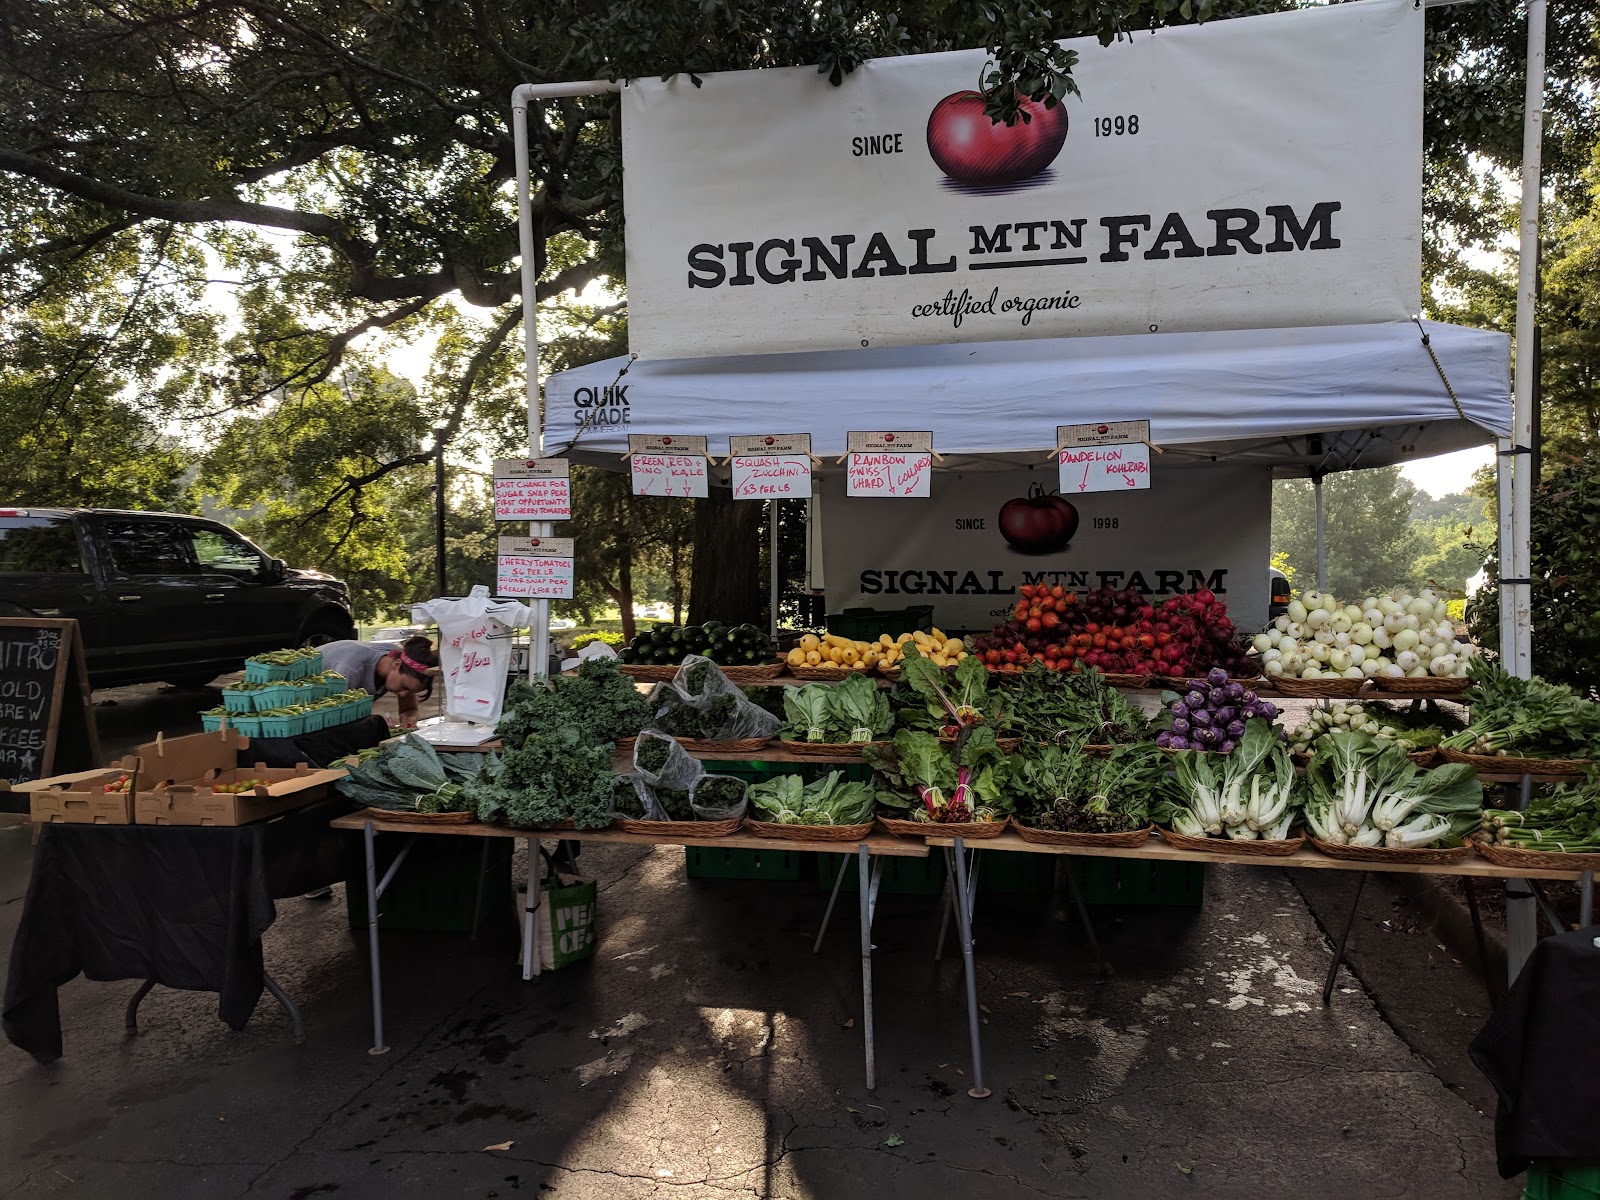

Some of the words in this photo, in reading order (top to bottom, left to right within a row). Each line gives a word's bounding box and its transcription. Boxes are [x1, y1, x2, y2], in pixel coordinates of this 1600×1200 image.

[852, 133, 903, 157] SINCE
[1094, 114, 1140, 138] 1998
[687, 228, 957, 289] SIGNAL
[968, 218, 1088, 255] MTN
[1099, 201, 1341, 263] FARM
[911, 286, 998, 329] certified
[1001, 289, 1081, 326] organic
[573, 384, 631, 408] QUIK
[573, 407, 632, 427] SHADE
[668, 456, 693, 467] RED
[735, 456, 781, 469] SQUASH
[853, 453, 906, 467] RAINBOW
[1059, 448, 1123, 465] DANDELION
[633, 465, 663, 475] DINO
[671, 468, 704, 477] KALE
[752, 468, 799, 478] ZUCCHINI
[848, 466, 881, 478] SWISS
[1106, 461, 1149, 475] KOHLRABI
[495, 480, 515, 489] LAST
[516, 480, 547, 488] CHANCE
[549, 480, 567, 488] FOR
[742, 483, 757, 495] $3
[759, 484, 776, 494] PER
[778, 483, 790, 492] LB
[852, 477, 885, 490] CHARD
[495, 491, 524, 499] SUGAR
[495, 499, 516, 507] FIRST
[496, 507, 511, 516] FOR
[512, 507, 538, 516] CHERRY
[955, 518, 986, 531] SINCE
[1092, 517, 1119, 530] 1998
[498, 557, 533, 567] CHERRY
[534, 559, 571, 569] TOMATOES
[527, 567, 542, 576] PER
[544, 568, 554, 576] LB
[498, 576, 525, 584] SUGAR
[549, 578, 568, 586] PEAS
[859, 569, 1016, 596] SIGNAL
[1022, 571, 1090, 587] MTN
[1095, 568, 1228, 595] FARM
[463, 651, 491, 673] You
[0, 680, 42, 701] OLD
